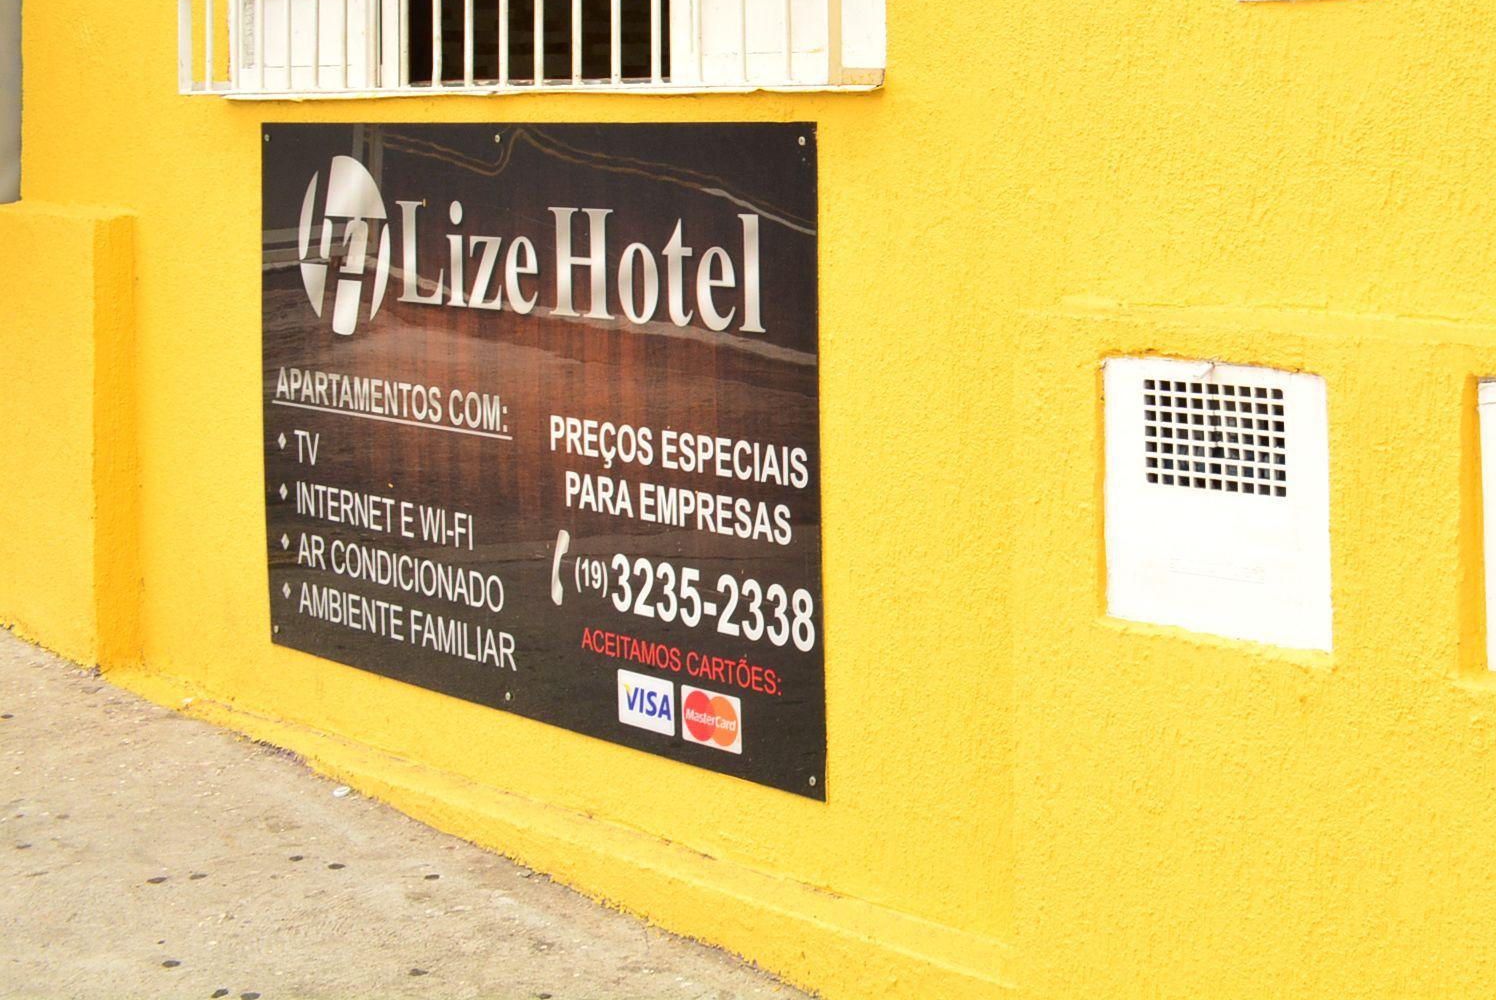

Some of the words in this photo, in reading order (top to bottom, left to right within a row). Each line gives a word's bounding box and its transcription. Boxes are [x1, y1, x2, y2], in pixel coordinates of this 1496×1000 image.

[276, 366, 442, 422] APARTAMENTOS
[449, 389, 508, 433] COM:
[294, 429, 319, 466] TV
[550, 414, 654, 469] PREÇOS
[661, 430, 809, 489] ESPECIAIS
[296, 481, 395, 533] INTERNET
[401, 501, 414, 538] E
[419, 504, 473, 551] WI-FI
[565, 470, 634, 518] PARA
[639, 482, 792, 546] EMPRESAS
[297, 532, 326, 570] AR
[331, 540, 505, 613] CONDICIONADO
[611, 553, 815, 652] 3235-2338
[299, 582, 404, 641] AMBIENTE
[410, 609, 517, 672] FAMILIAR
[581, 627, 681, 672] ACEITAMOS
[686, 652, 782, 696] CARTÕES:
[624, 683, 672, 721] VISA
[685, 708, 737, 732] MasterCard
